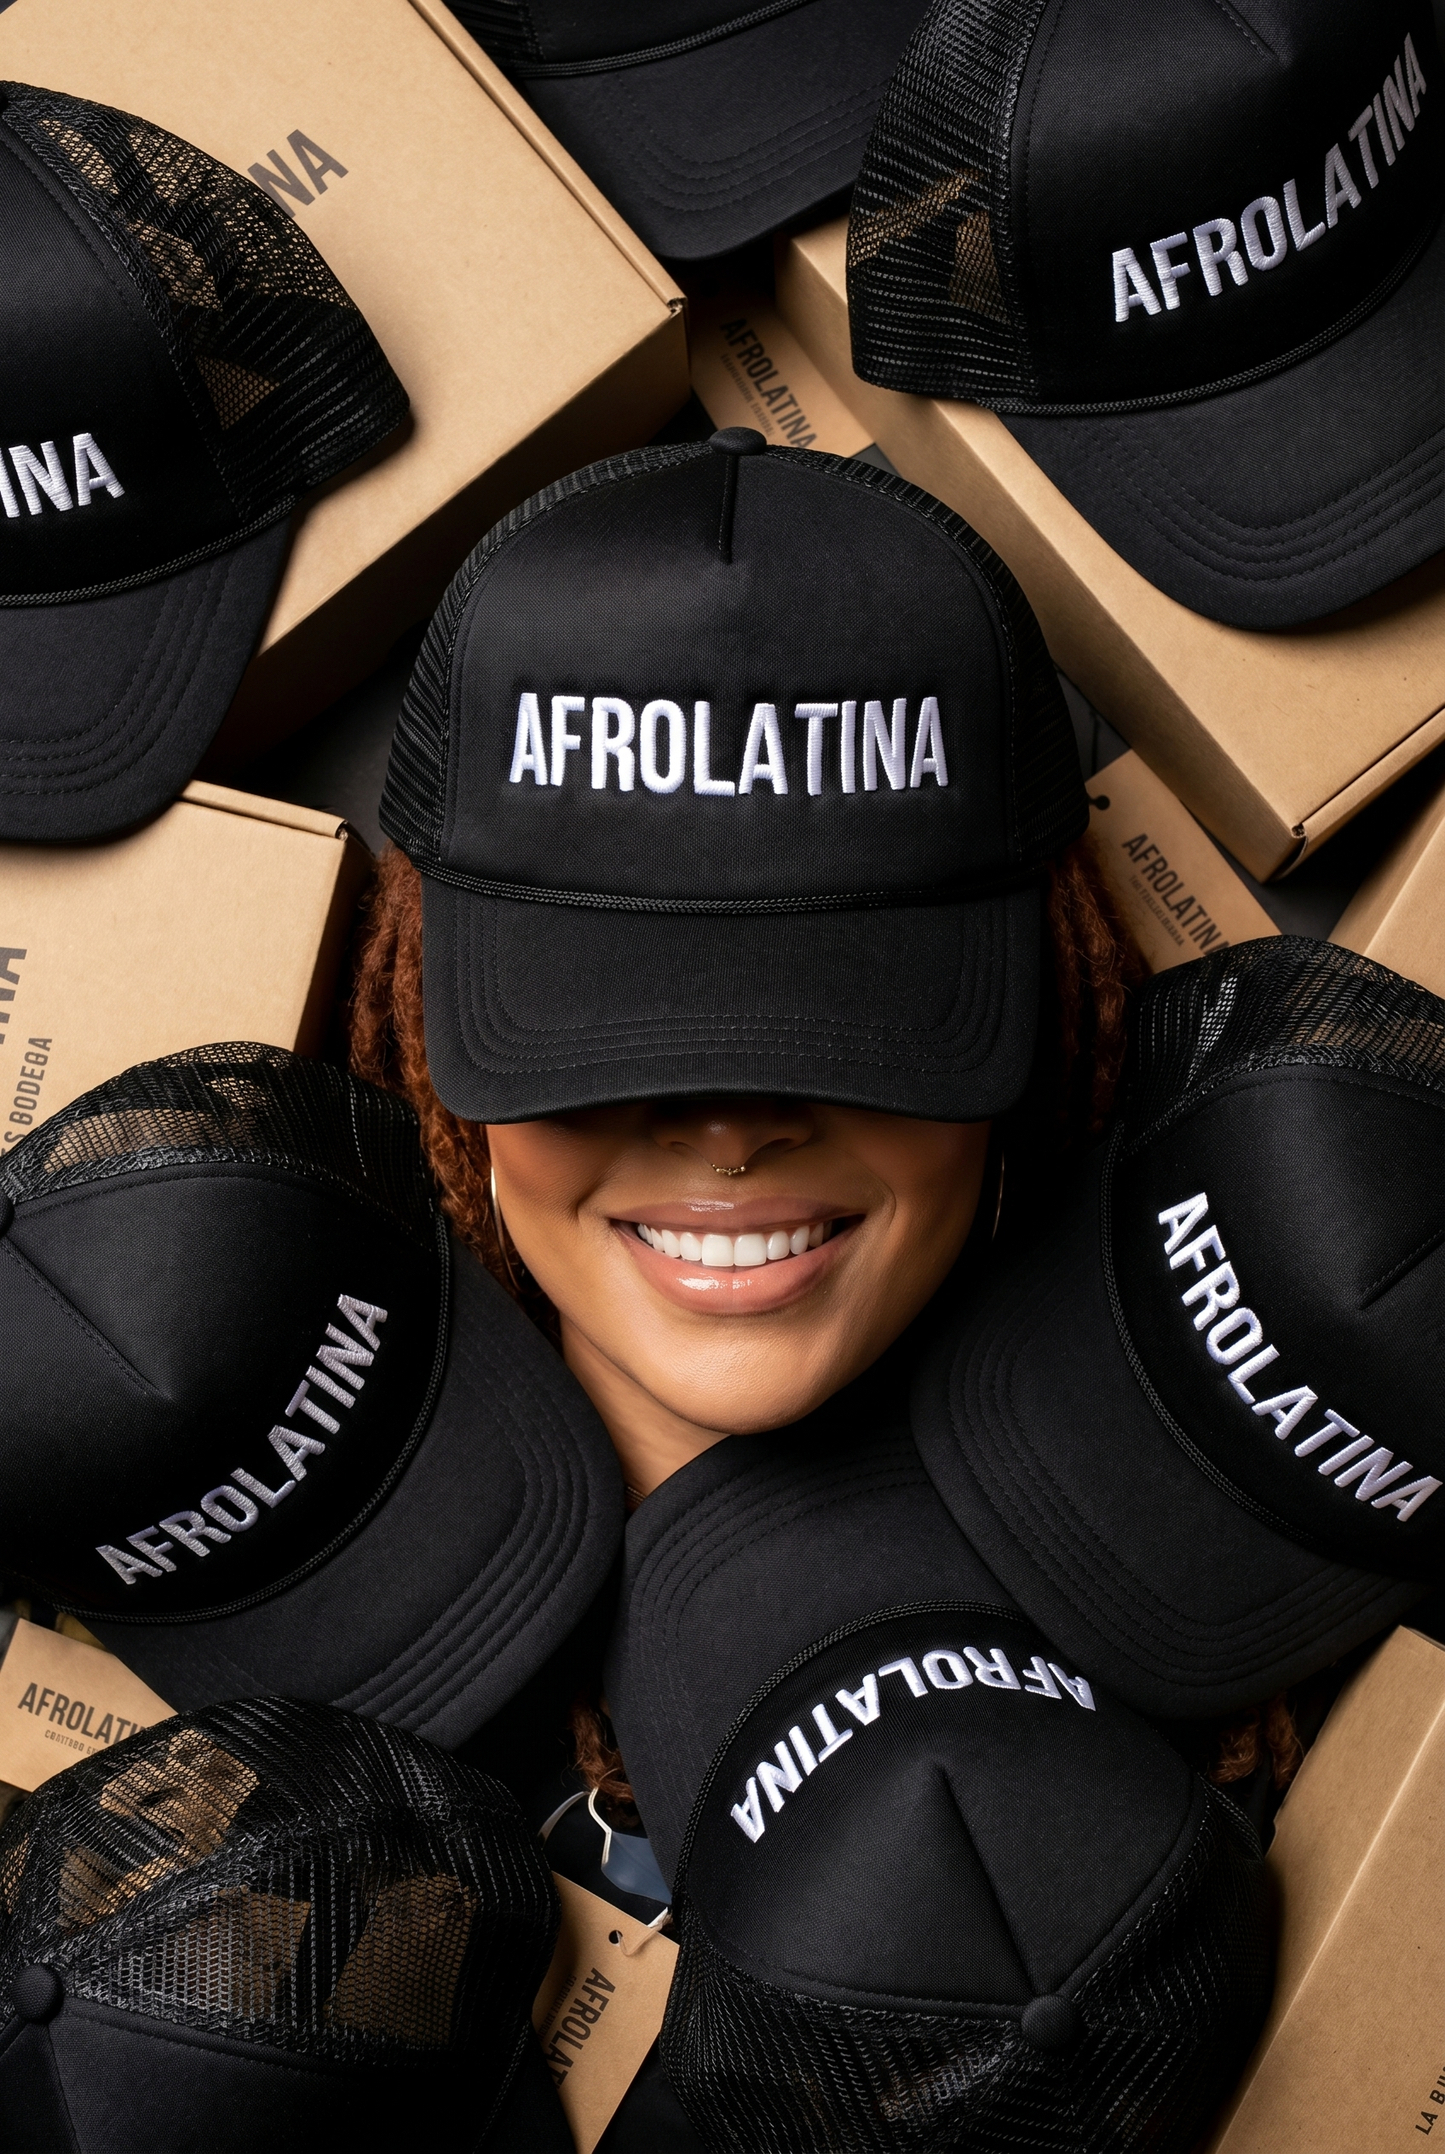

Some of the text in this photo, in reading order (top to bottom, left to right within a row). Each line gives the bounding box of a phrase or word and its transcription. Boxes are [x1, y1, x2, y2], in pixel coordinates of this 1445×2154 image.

[1111, 31, 1428, 323] AFROLATINA
[719, 319, 818, 449] AFROLATINA
[509, 692, 948, 796] AFROLATINA
[1158, 1191, 1443, 1522] AFROLATINA
[95, 1293, 388, 1585] AFROLATINA
[17, 1682, 147, 1745] AFROLAT
[730, 1646, 1097, 1843] AFROLATINA
[546, 1967, 616, 2089] AFROLAT
[1414, 2110, 1439, 2136] LA
